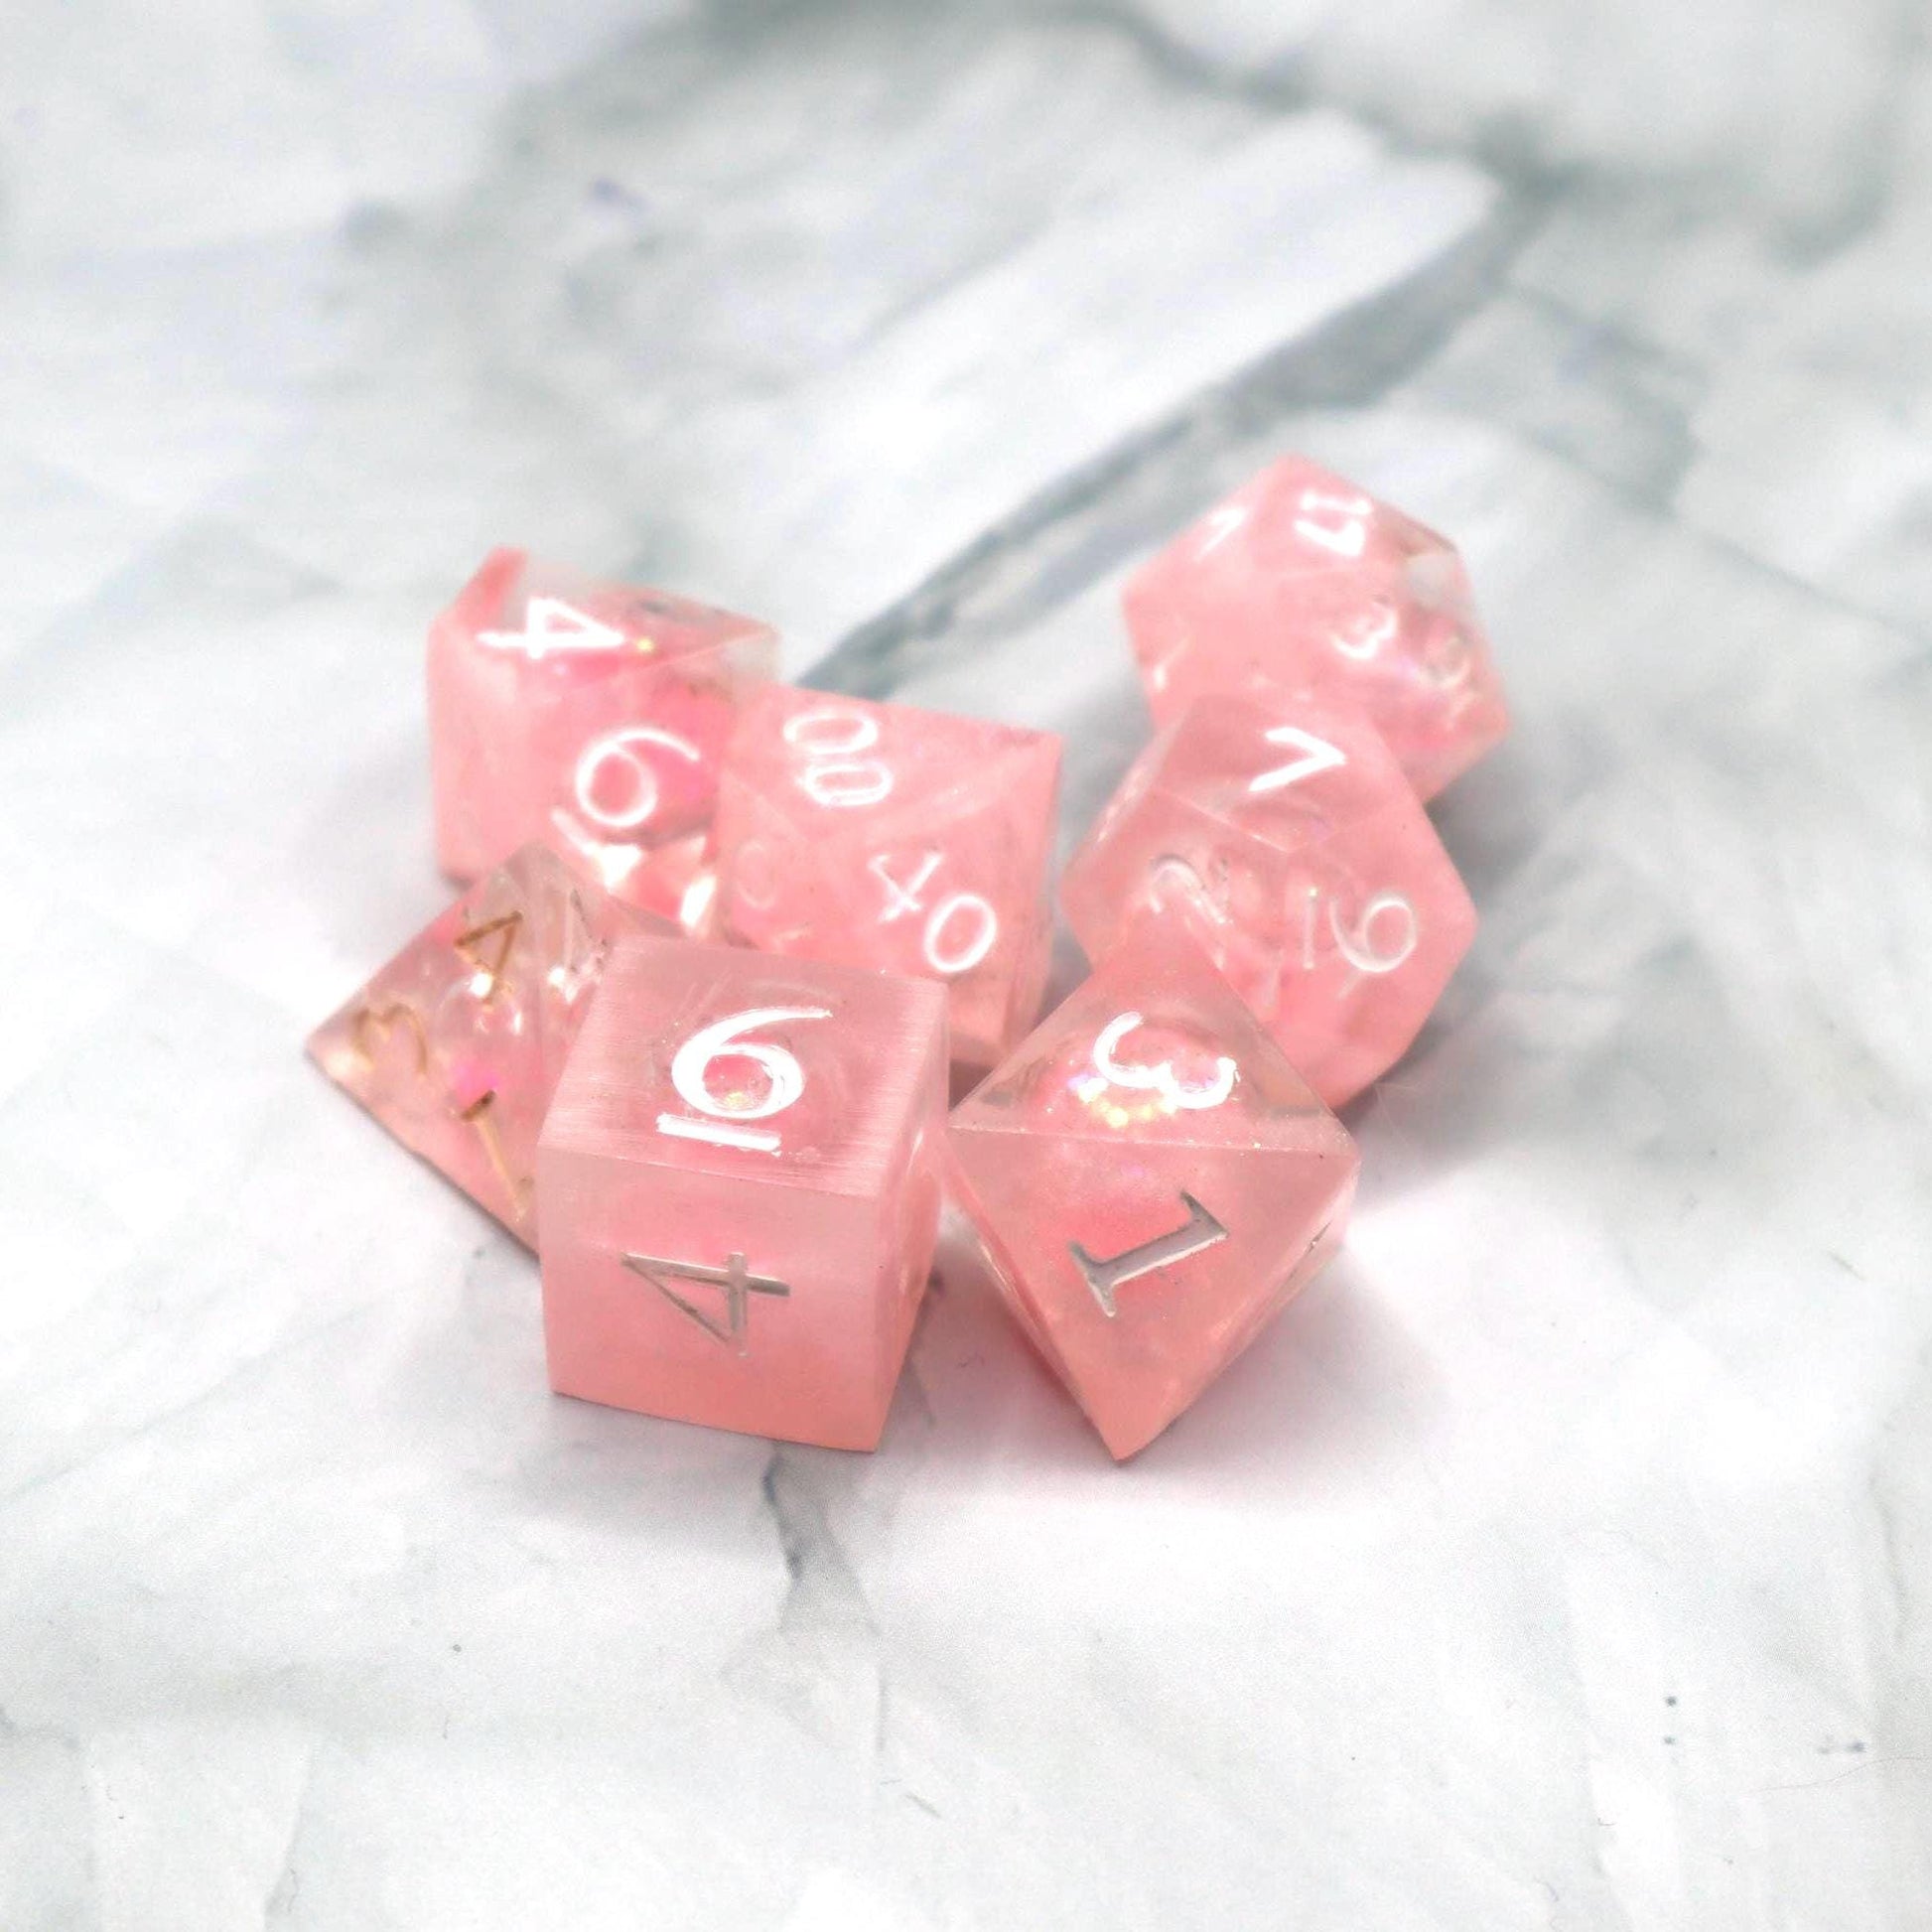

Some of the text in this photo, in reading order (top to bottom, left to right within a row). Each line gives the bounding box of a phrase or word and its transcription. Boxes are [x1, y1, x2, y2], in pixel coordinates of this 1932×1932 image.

[477, 598, 625, 659] 4
[783, 708, 894, 807] 00
[1248, 726, 1347, 792] 7
[655, 1006, 832, 1159] 6
[1093, 1011, 1241, 1111] 3
[1068, 1189, 1231, 1318] 1
[621, 1251, 791, 1357] 4
